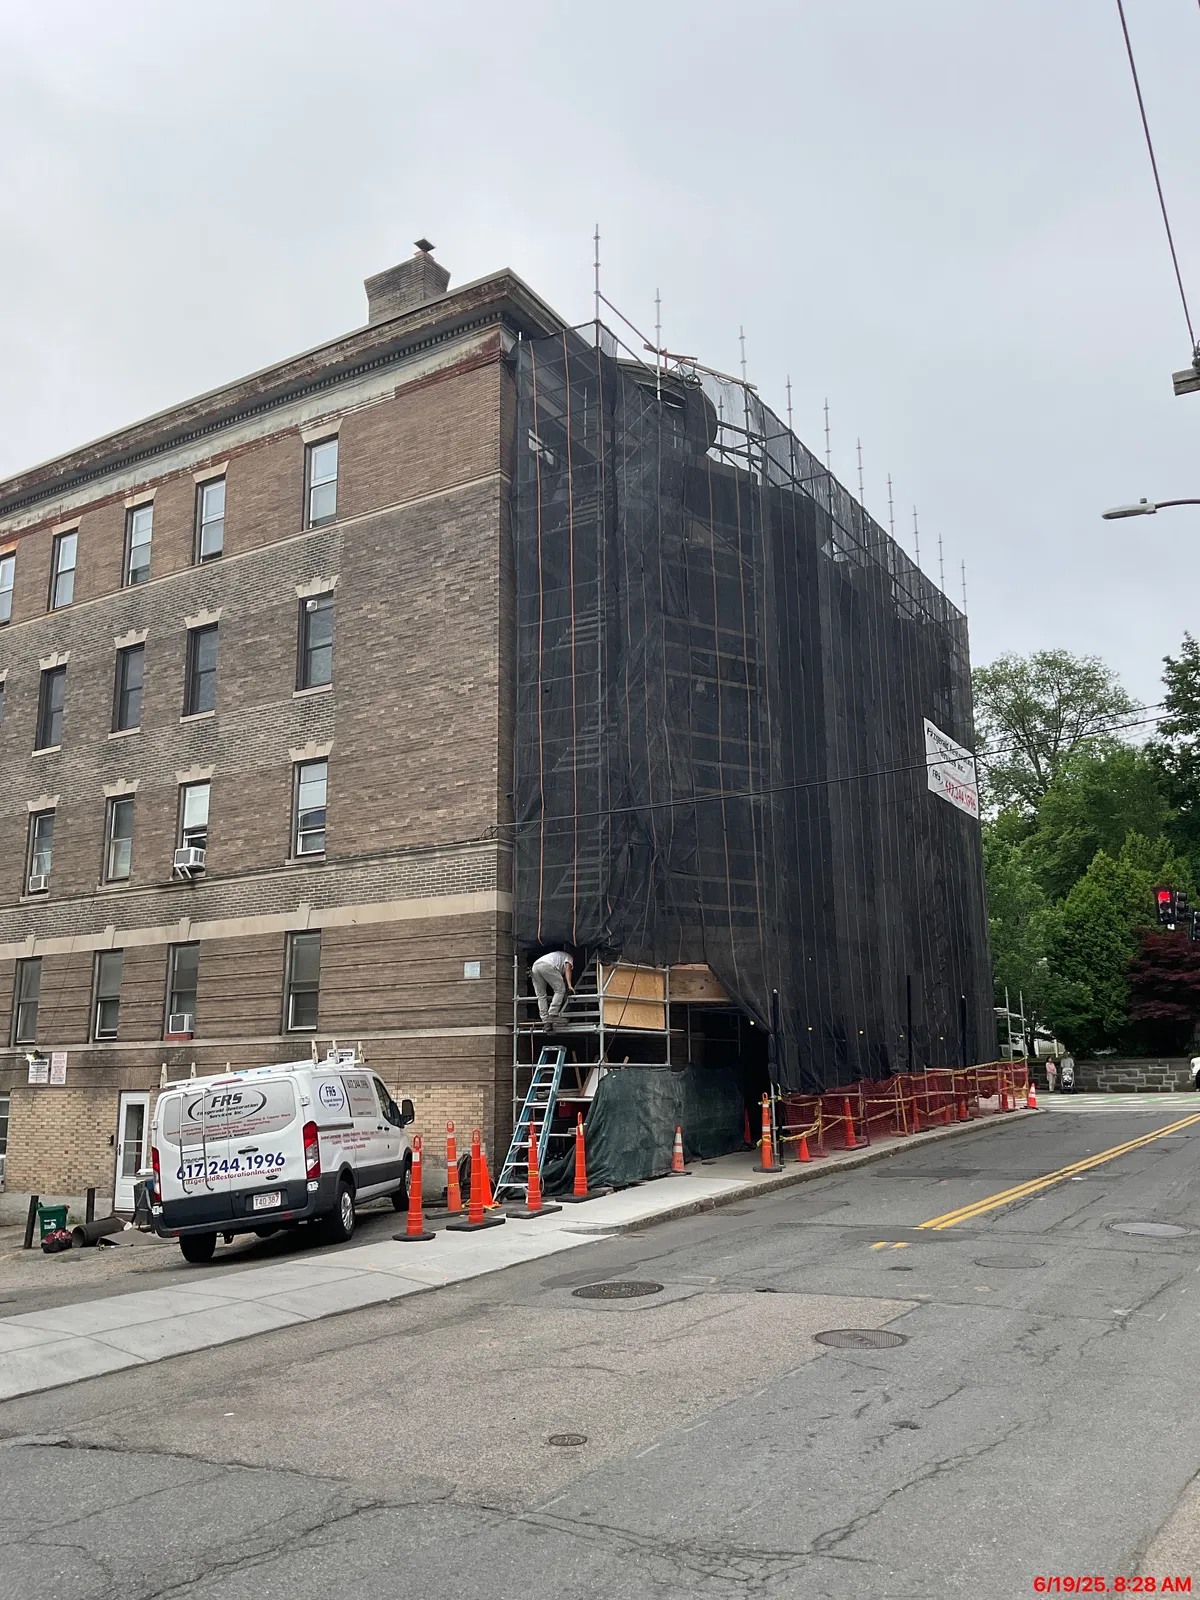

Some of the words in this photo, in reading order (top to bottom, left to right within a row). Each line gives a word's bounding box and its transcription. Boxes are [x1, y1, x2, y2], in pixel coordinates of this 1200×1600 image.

[325, 1085, 336, 1097] FRS
[211, 1092, 243, 1108] FRS
[176, 1152, 285, 1180] 617.244.1996
[183, 1167, 282, 1185] itzgeraldRestorationInc.com
